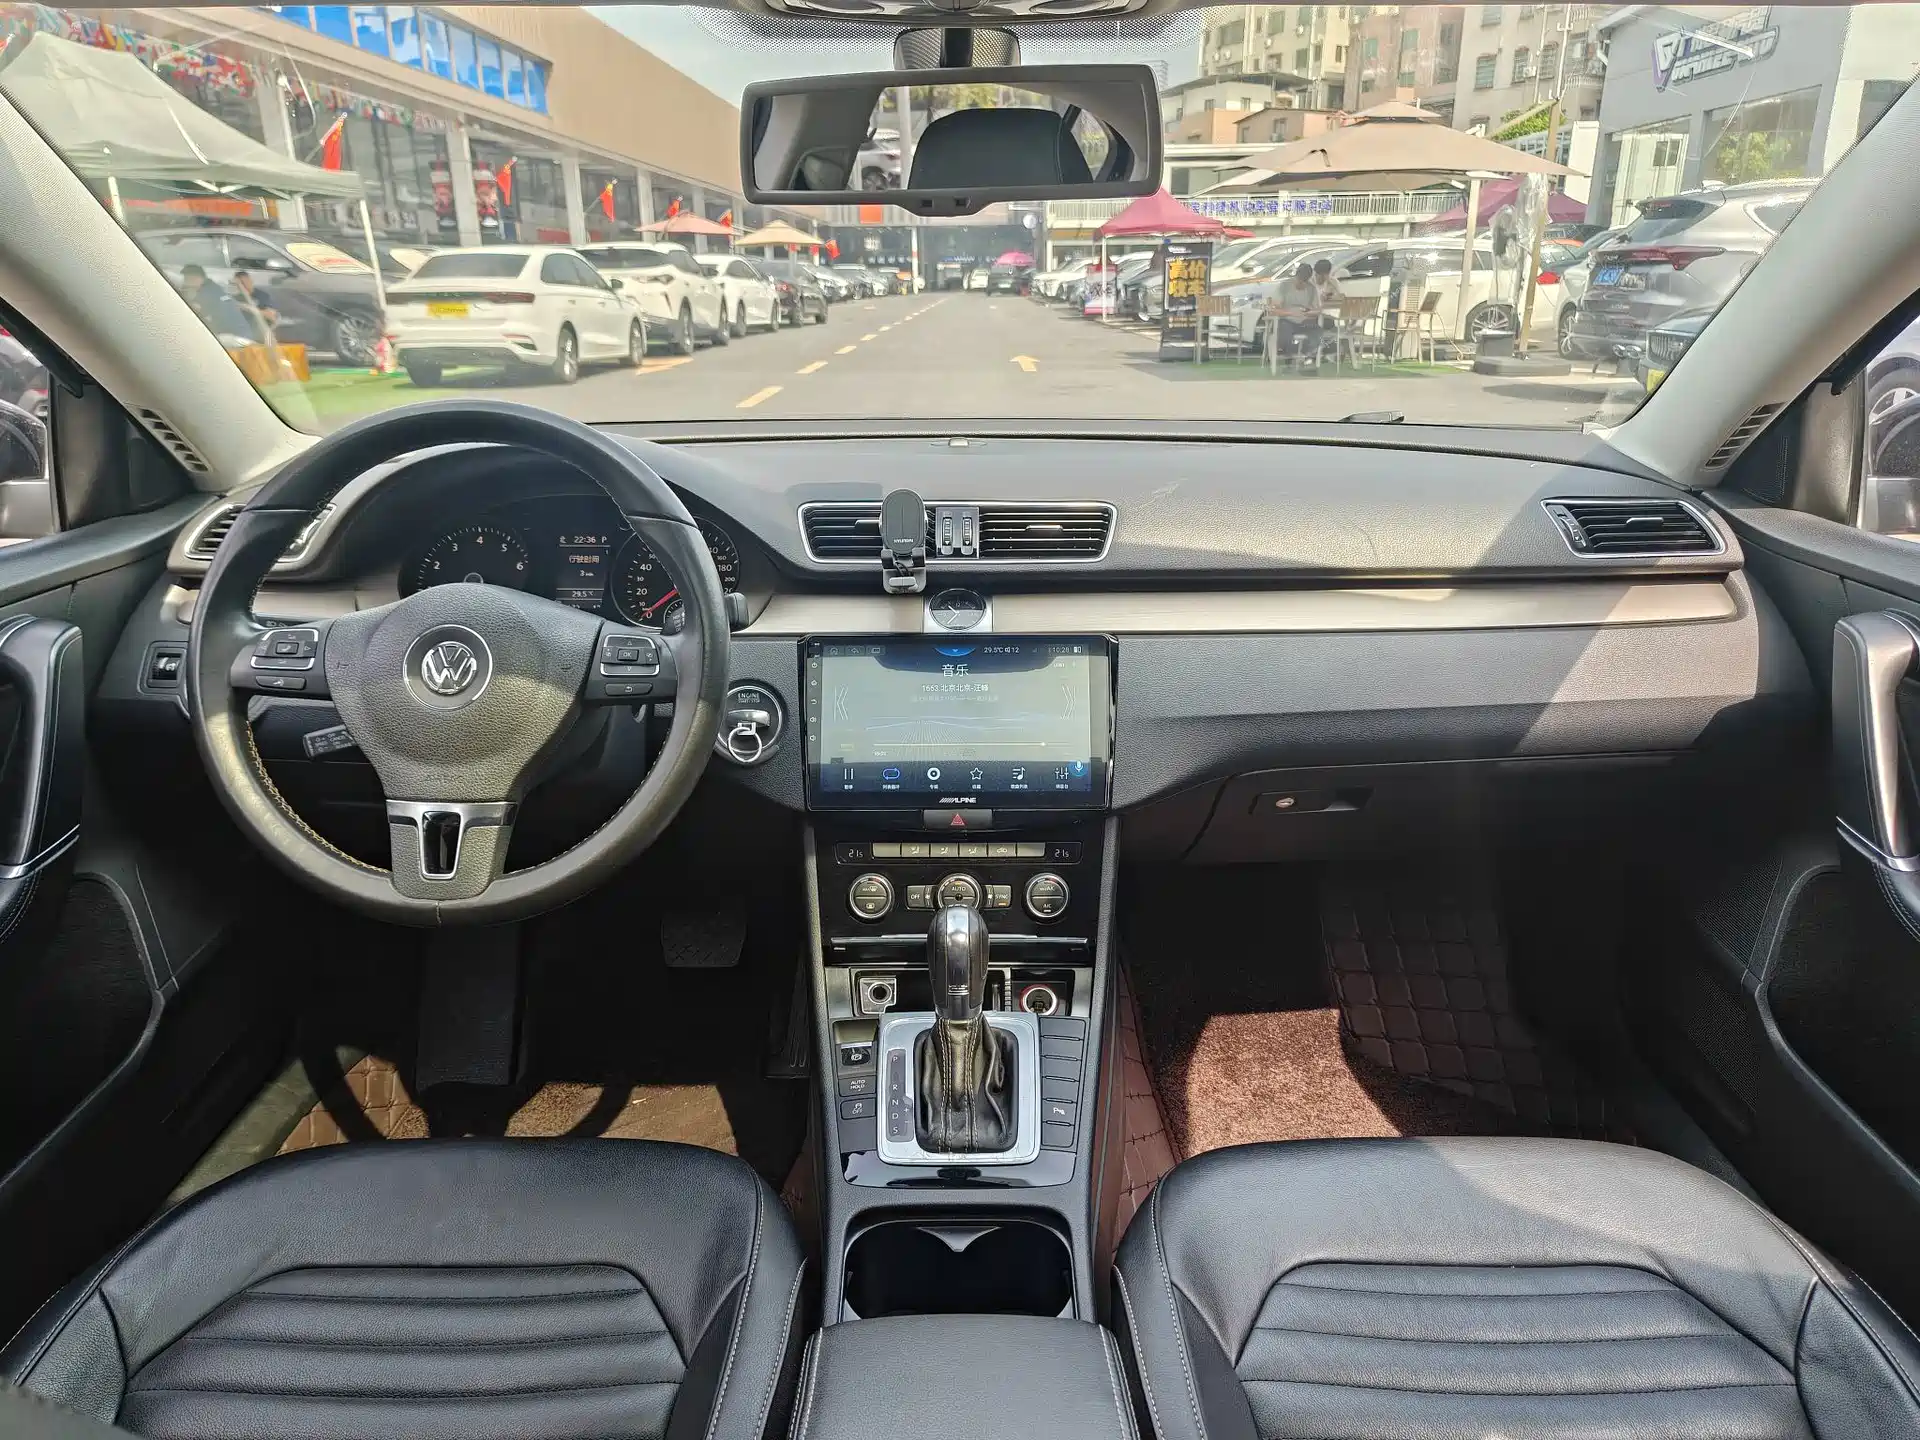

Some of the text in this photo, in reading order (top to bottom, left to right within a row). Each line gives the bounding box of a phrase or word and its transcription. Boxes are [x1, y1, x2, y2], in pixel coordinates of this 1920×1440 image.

[1169, 256, 1206, 279] 高价
[476, 536, 483, 544] 4
[452, 543, 458, 552] 3
[501, 543, 508, 552] 5
[569, 555, 600, 563] 行驶时间
[433, 561, 440, 570] 2
[516, 562, 524, 571] 6
[640, 563, 652, 571] 40
[942, 664, 969, 677] 音乐
[893, 1126, 899, 1134] S
